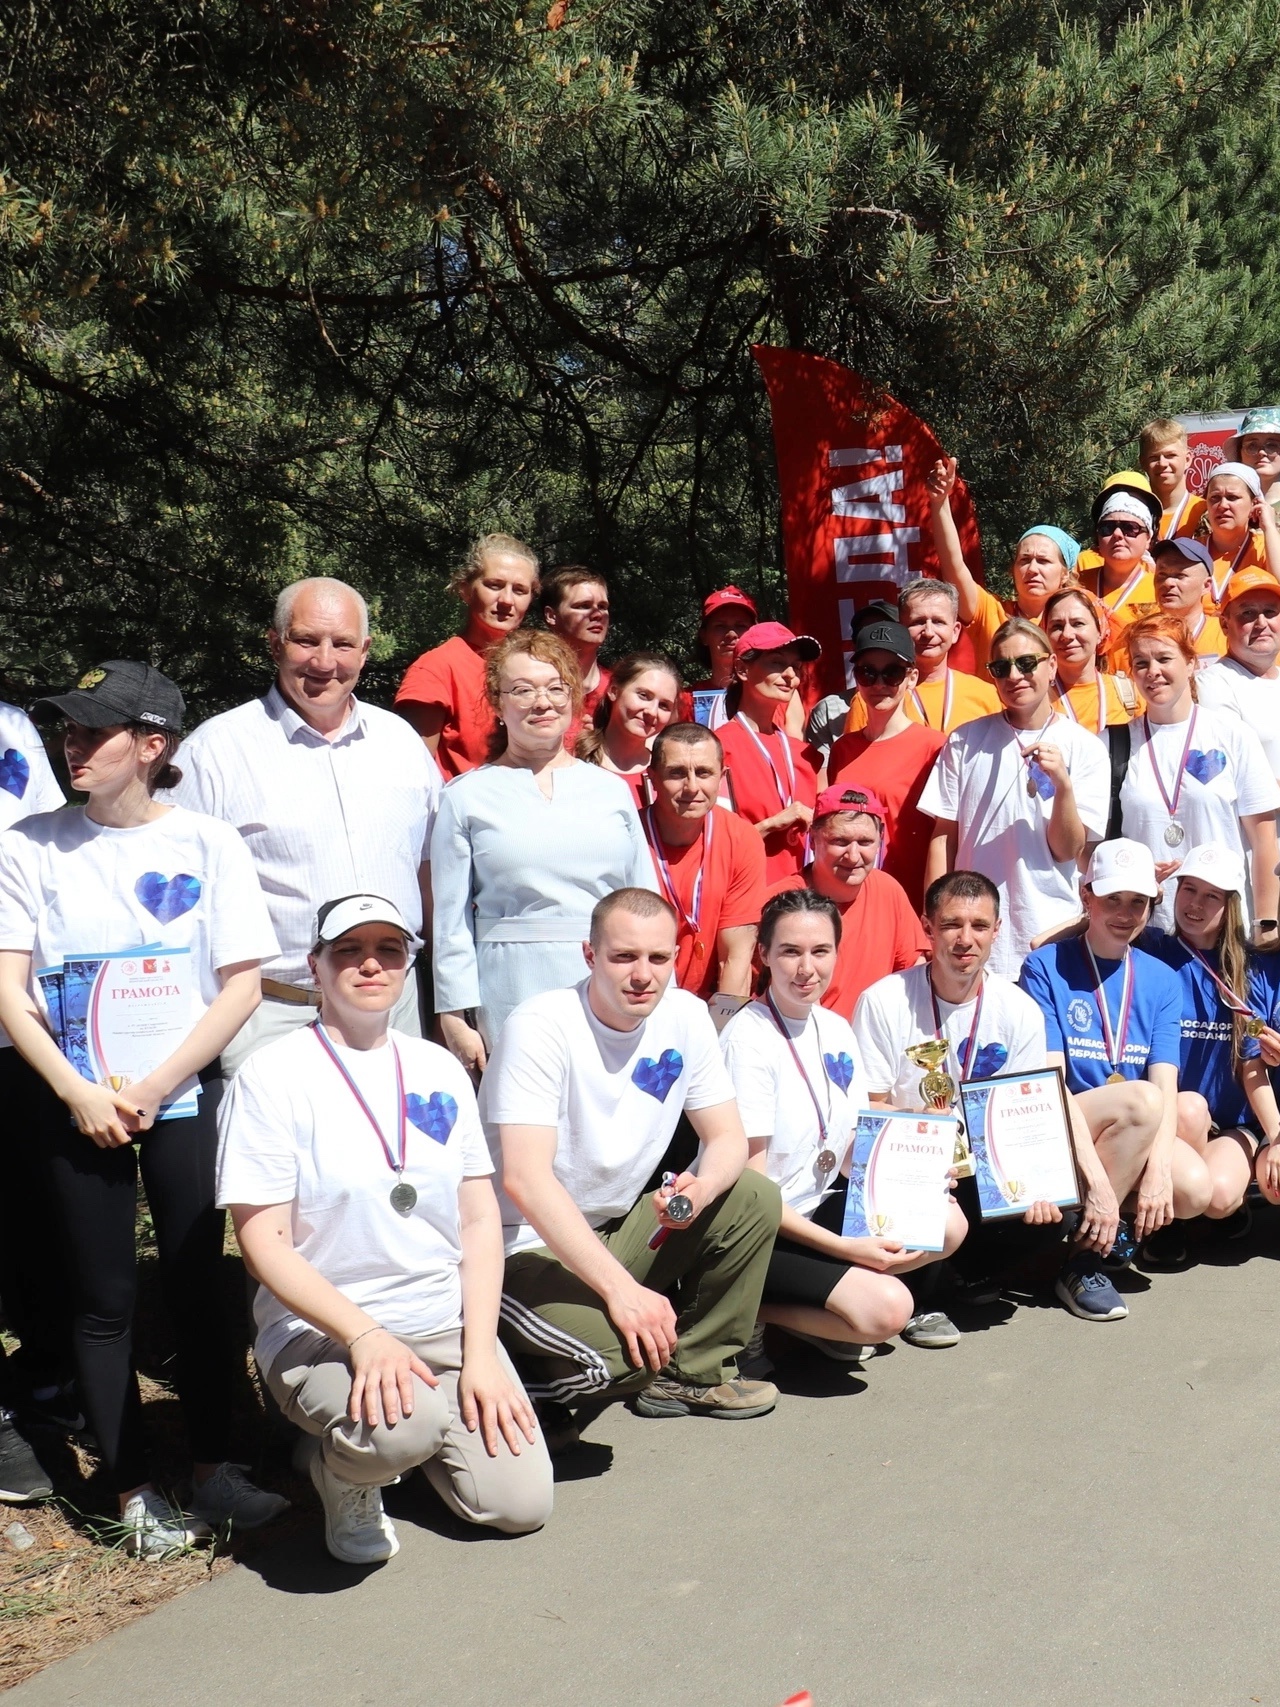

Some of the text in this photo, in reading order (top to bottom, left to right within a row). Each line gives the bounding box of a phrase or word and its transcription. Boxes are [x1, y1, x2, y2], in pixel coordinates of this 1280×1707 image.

[112, 985, 180, 999] ГРАМОТА
[1000, 1102, 1053, 1118] ГРАМОТА
[890, 1142, 944, 1156] ГРАМОТА
